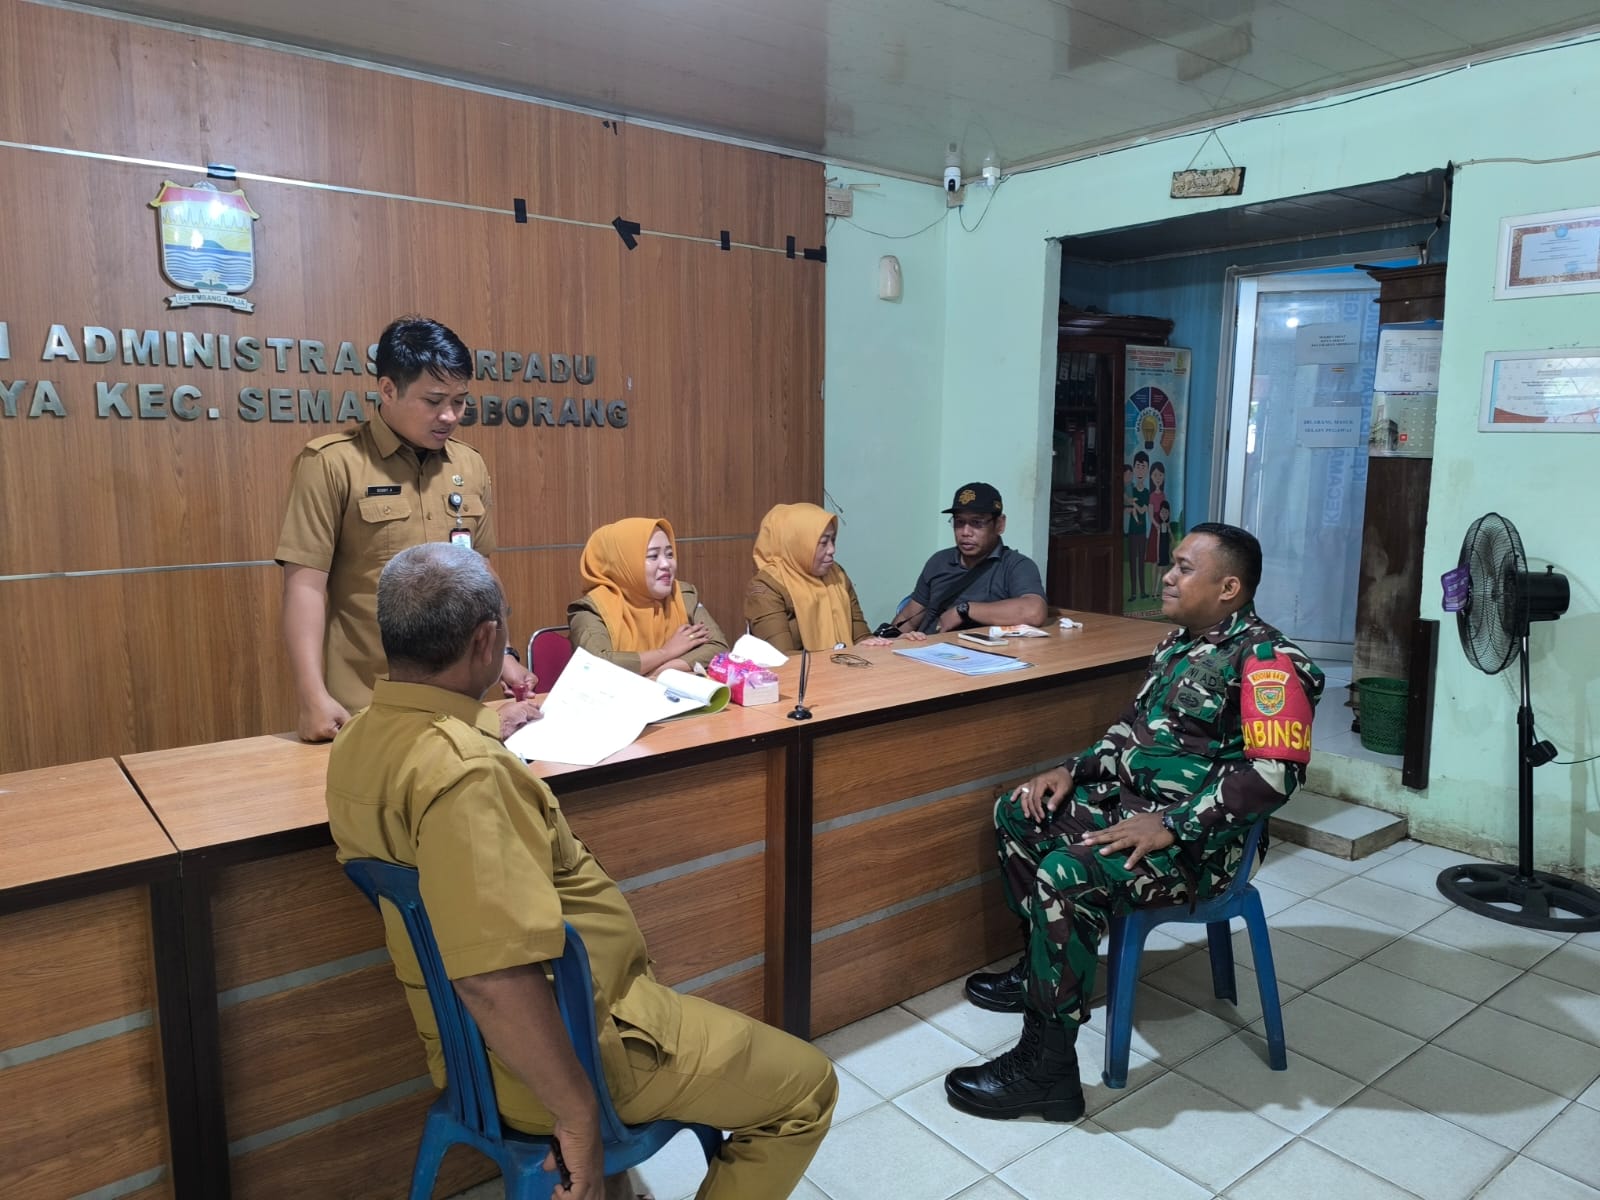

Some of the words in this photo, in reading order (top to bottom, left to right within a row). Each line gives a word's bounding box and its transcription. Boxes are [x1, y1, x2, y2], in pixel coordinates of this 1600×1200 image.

[42, 324, 379, 377] ADMINISTRAS
[475, 350, 597, 385] RPADU
[95, 381, 220, 420] KEC.
[1241, 719, 1311, 752] ABINSA
